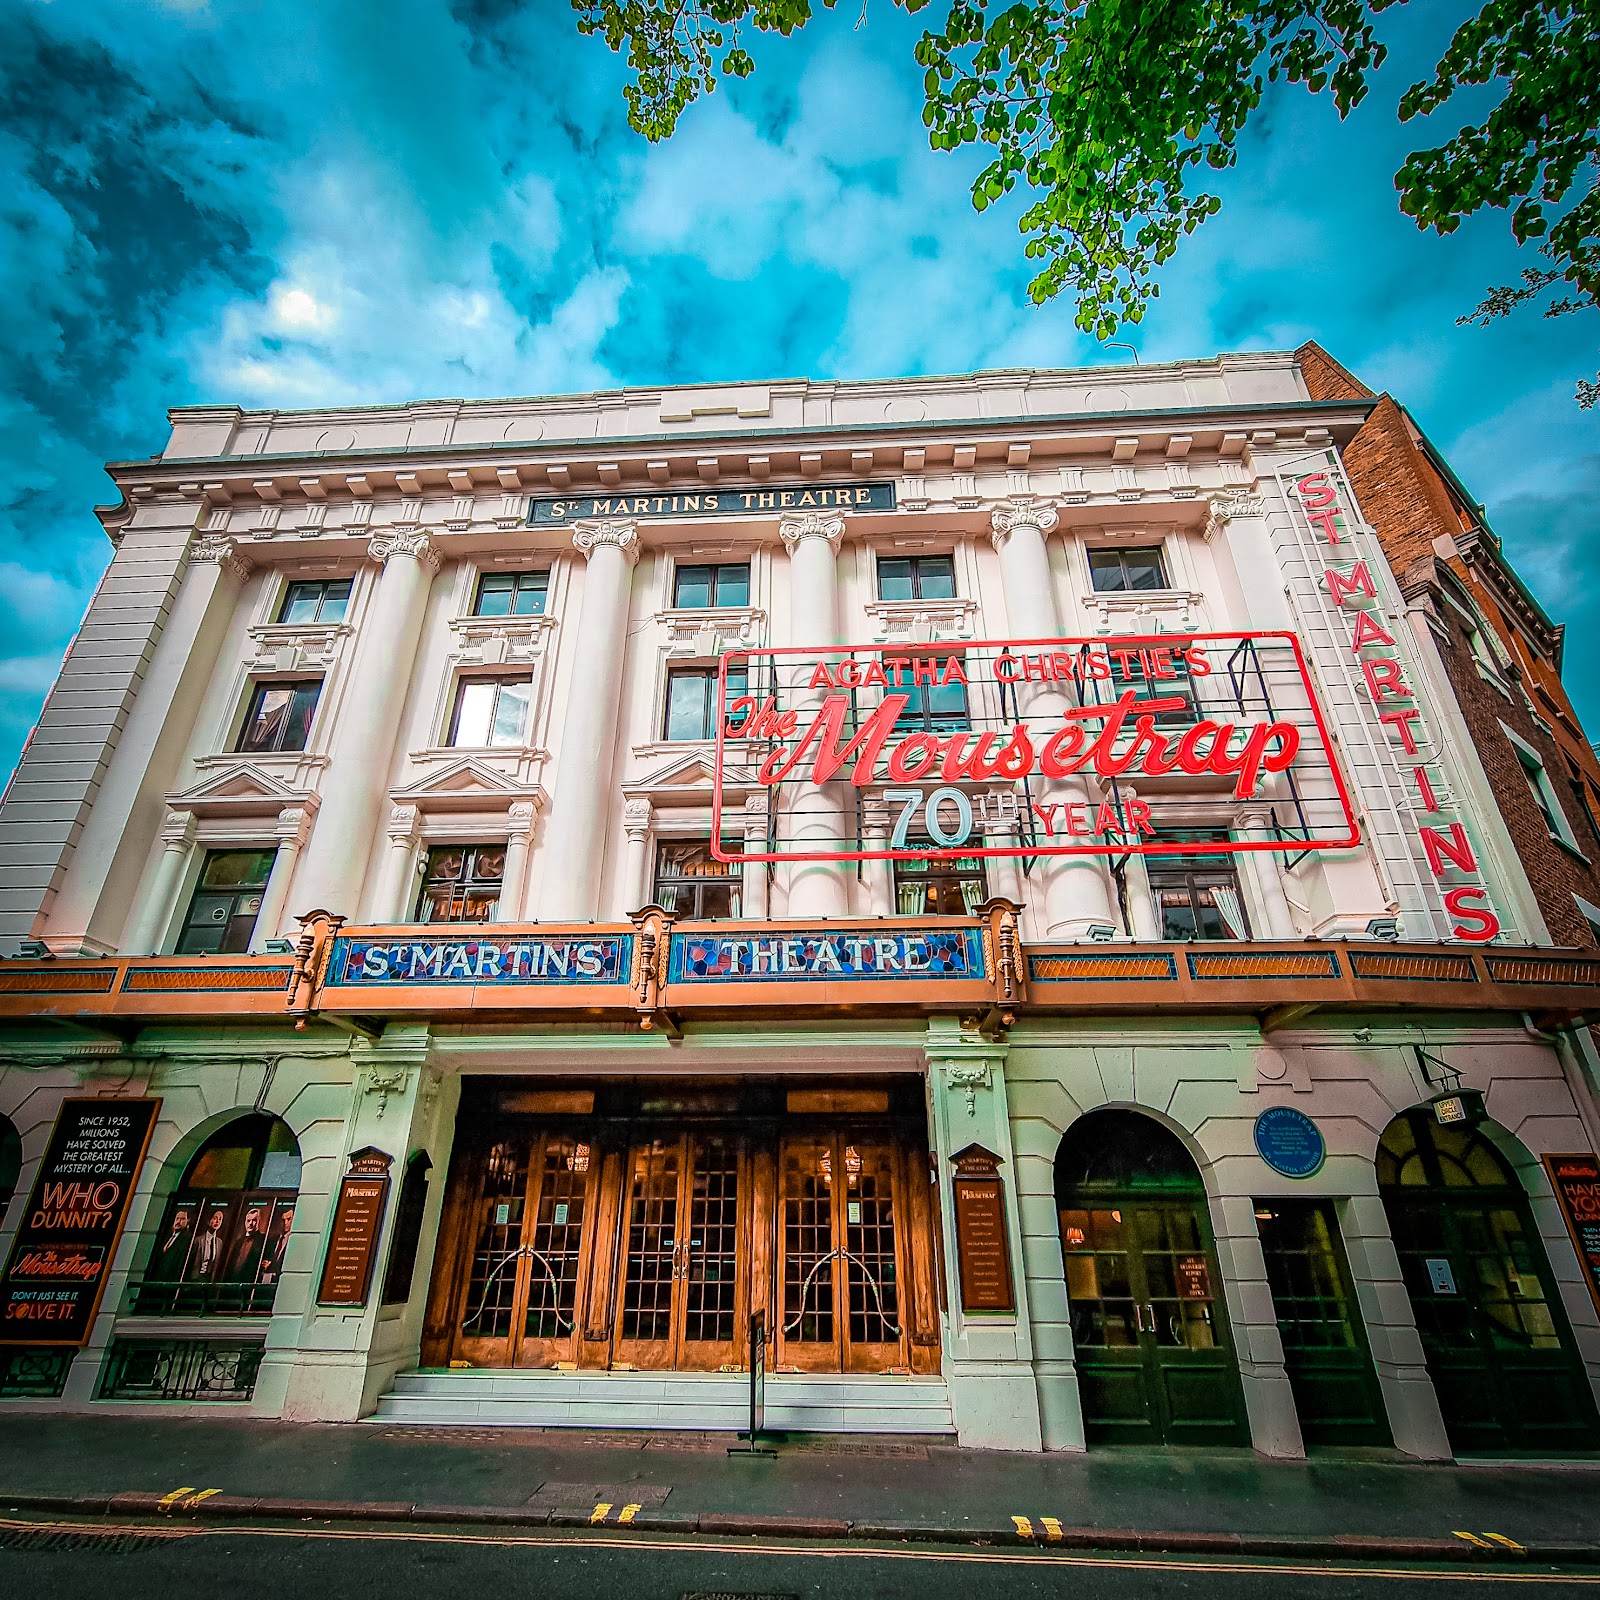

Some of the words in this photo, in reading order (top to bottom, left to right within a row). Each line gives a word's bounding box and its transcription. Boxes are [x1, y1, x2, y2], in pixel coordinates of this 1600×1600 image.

[592, 495, 720, 515] MARTINS
[739, 488, 873, 509] THEATRE
[808, 656, 968, 689] AGATHA
[993, 647, 1213, 684] CHRISTIE'S
[725, 695, 798, 740] The
[757, 689, 1303, 798] Mousetrap
[1324, 560, 1500, 941] MARTINS
[1032, 800, 1157, 837] YEAR
[408, 944, 603, 977] MARTIN'S
[722, 938, 932, 974] THEATRE
[79, 1117, 105, 1126] SINCE
[108, 1117, 131, 1127] 1952,
[79, 1129, 120, 1137] MILLIONS
[1268, 1110, 1317, 1136] MOUSETRAP
[62, 1152, 79, 1161] THE
[80, 1152, 123, 1161] GREATEST
[66, 1140, 92, 1149] HAVE
[92, 1140, 126, 1149] SOLVED
[53, 1164, 92, 1173] MYSTERY
[94, 1164, 108, 1173] OF
[42, 1181, 120, 1210] WHO
[30, 1211, 113, 1229] DUNNIT?
[10, 1253, 102, 1280] Mousetrap
[11, 1291, 37, 1300] DON'T
[37, 1291, 55, 1300] JUST
[56, 1291, 71, 1300] SEE
[5, 1303, 57, 1319] SOLVE
[58, 1303, 76, 1319] IT.
